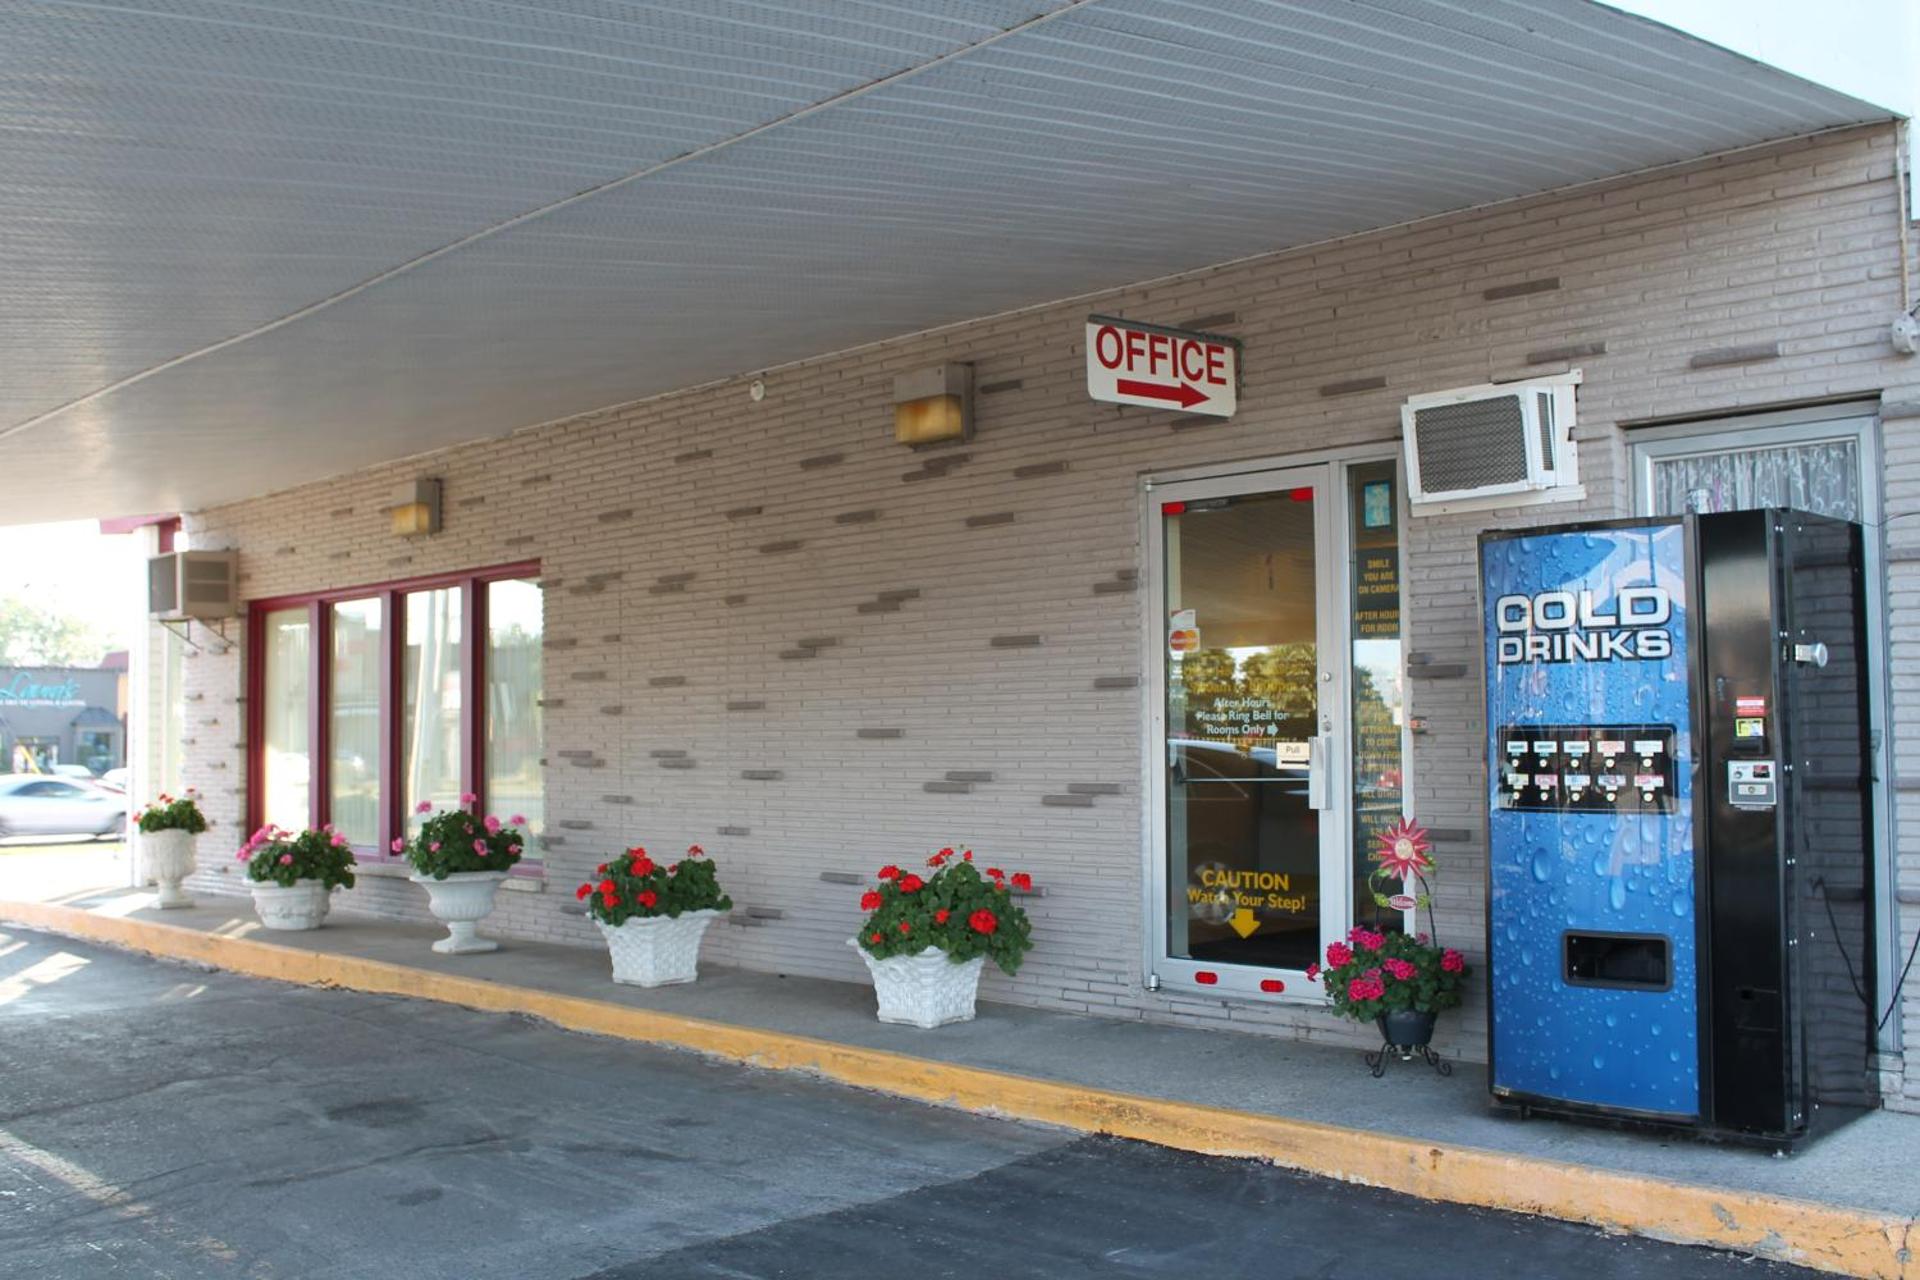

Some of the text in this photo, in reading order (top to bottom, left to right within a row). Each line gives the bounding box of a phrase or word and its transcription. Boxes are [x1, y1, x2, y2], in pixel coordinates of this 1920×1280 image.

[1096, 325, 1227, 385] OFFICE
[1368, 559, 1389, 569] SMILE
[1364, 572, 1393, 582] YOU ARE
[1358, 585, 1369, 594] ON
[1496, 586, 1671, 634] COLD
[1355, 611, 1378, 621] AFTER
[1361, 624, 1375, 632] FOR
[1497, 629, 1673, 665] DRINKS
[1213, 697, 1274, 708] After Hours
[1195, 709, 1288, 723] Please Ring Bell for
[1206, 724, 1266, 736] Rooms Only
[1285, 745, 1300, 754] Pull
[1201, 869, 1290, 891] CAUTION
[1233, 891, 1264, 907] Your
[1268, 893, 1305, 915] Step!
